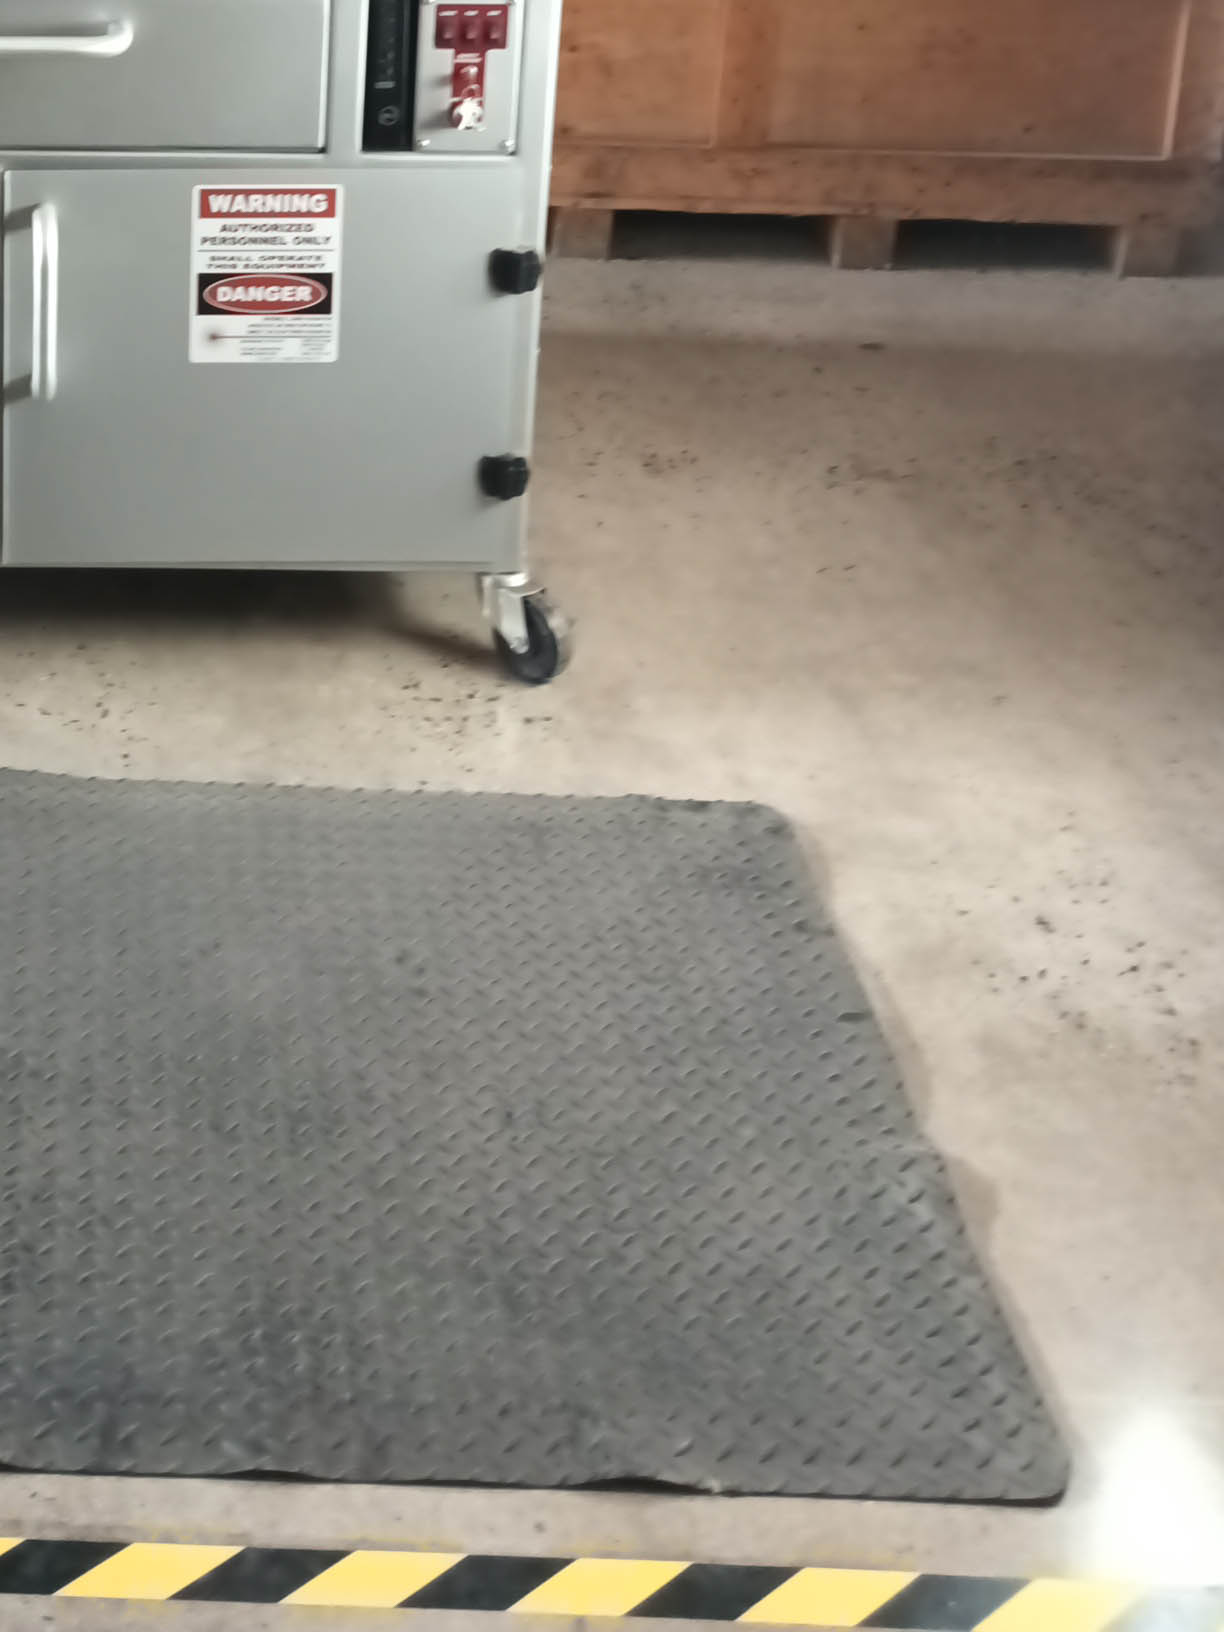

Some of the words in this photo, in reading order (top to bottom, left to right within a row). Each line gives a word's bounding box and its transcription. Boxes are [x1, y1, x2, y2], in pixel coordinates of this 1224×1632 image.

[208, 193, 329, 214] WARNING
[219, 223, 314, 233] AUTHORIZED
[200, 236, 288, 246] PERSONNEL
[292, 236, 332, 246] ONLY
[216, 286, 313, 302] DANGER
